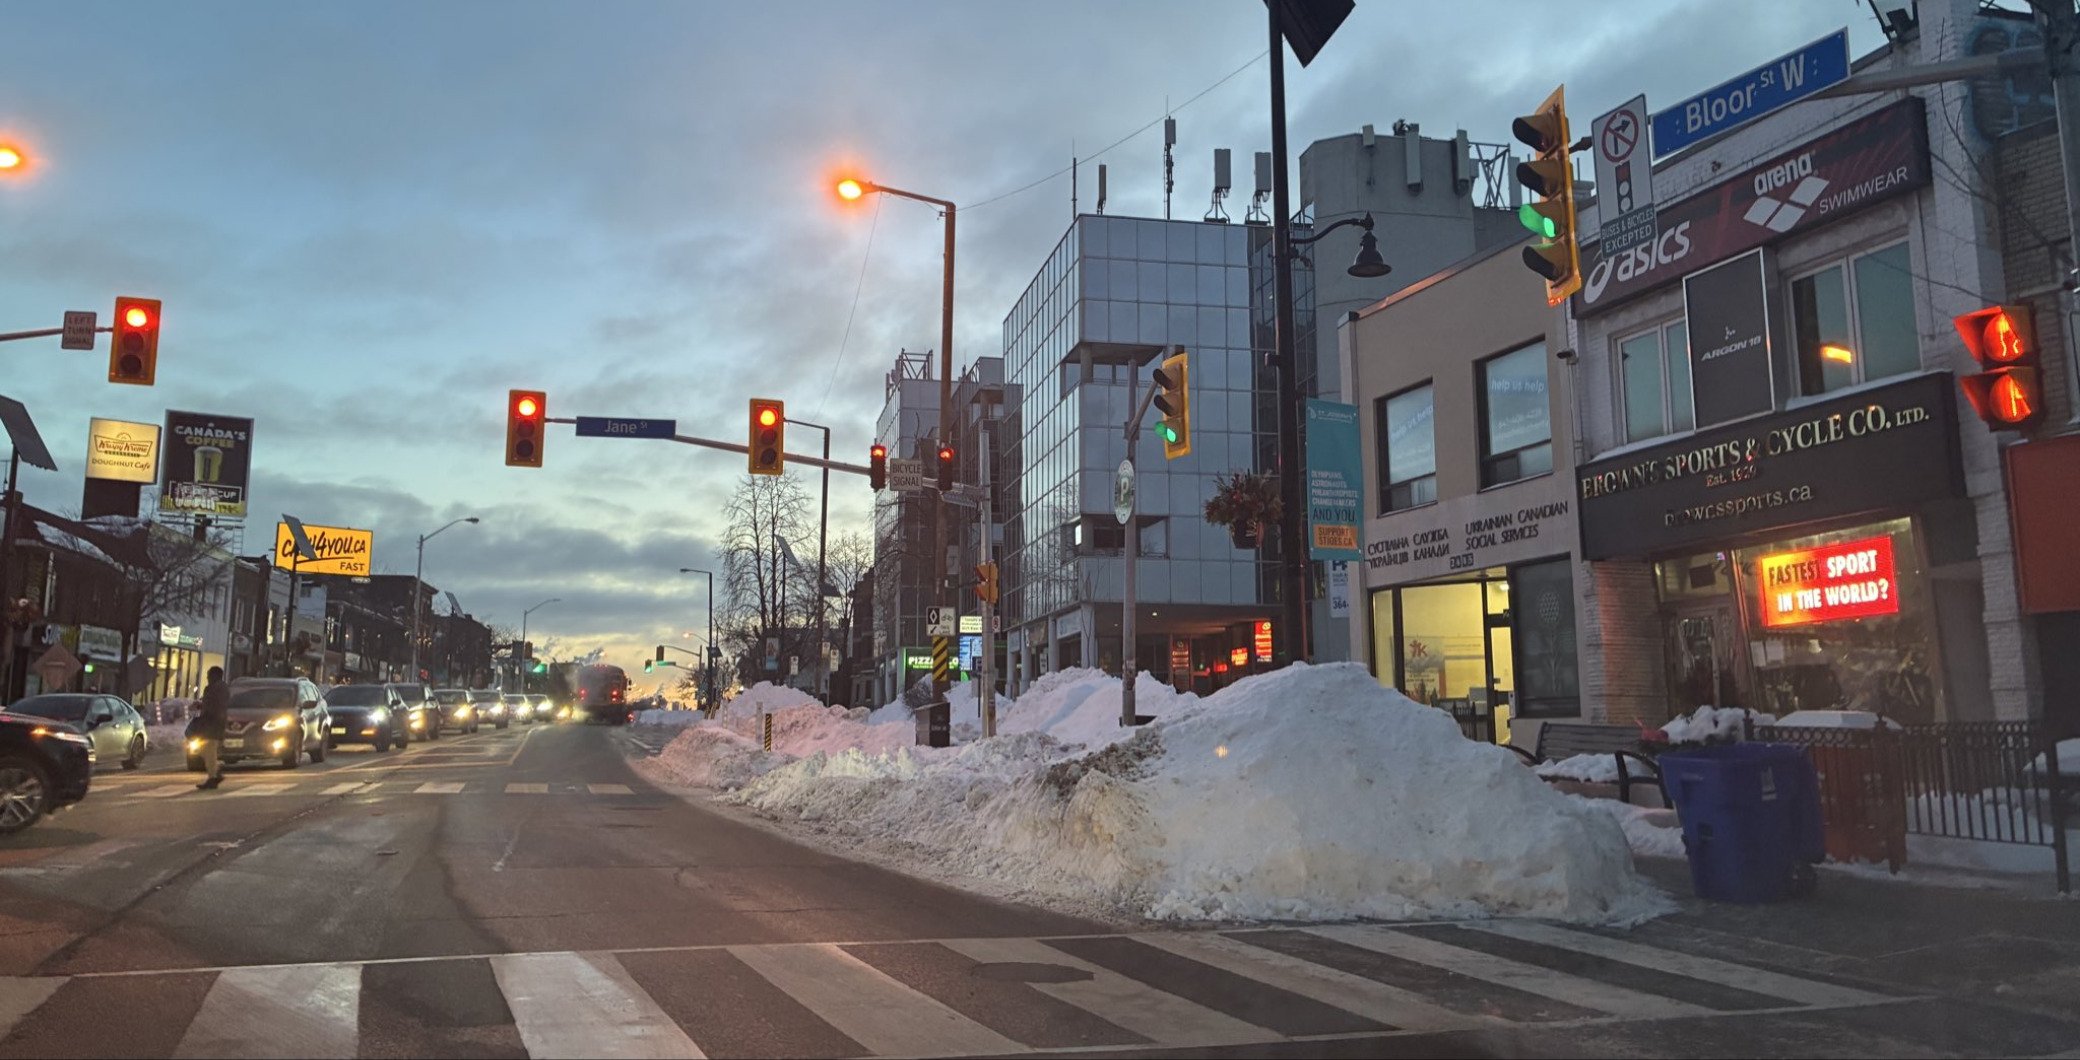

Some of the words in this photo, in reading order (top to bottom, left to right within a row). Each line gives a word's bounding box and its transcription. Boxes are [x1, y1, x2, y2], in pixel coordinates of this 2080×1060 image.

[1686, 82, 1755, 134] Bloor
[1760, 69, 1775, 88] St
[1780, 53, 1805, 91] W
[1754, 154, 1813, 196] arena
[1819, 166, 1908, 215] SWIMWEAR
[1601, 222, 1621, 240] BUSES
[1621, 219, 1628, 232] &
[1627, 206, 1655, 231] BICYCLES
[1605, 225, 1652, 253] EXCEPTED
[1701, 339, 1748, 362] ARGON
[1524, 379, 1545, 393] help
[175, 425, 247, 440] CANADA'S
[605, 420, 637, 434] Jane
[640, 421, 648, 429] St
[184, 435, 235, 448] COFFEE
[1664, 439, 1741, 481] SPORTS
[1745, 438, 1761, 462] &
[1766, 415, 1844, 456] CYCLE
[1848, 404, 1892, 437] CO.
[1896, 406, 1930, 427] LTD.
[91, 458, 134, 468] DOUGHNUT
[893, 463, 921, 474] BICYCLE
[894, 476, 920, 487] SIGNAL
[1312, 508, 1331, 521] AND
[1334, 509, 1357, 523] YOU.
[1465, 513, 1513, 536] UKRAINIAN
[1517, 500, 1568, 524] CANADIAN
[1465, 532, 1497, 551] SOCIAL
[1501, 523, 1539, 544] SERVICES
[339, 561, 365, 572] FAST
[1768, 558, 1822, 587] FASTEST
[1827, 549, 1878, 578] SPORT
[1776, 591, 1794, 612] IN
[1796, 587, 1823, 611] THE
[1825, 578, 1889, 606] WORLD?
